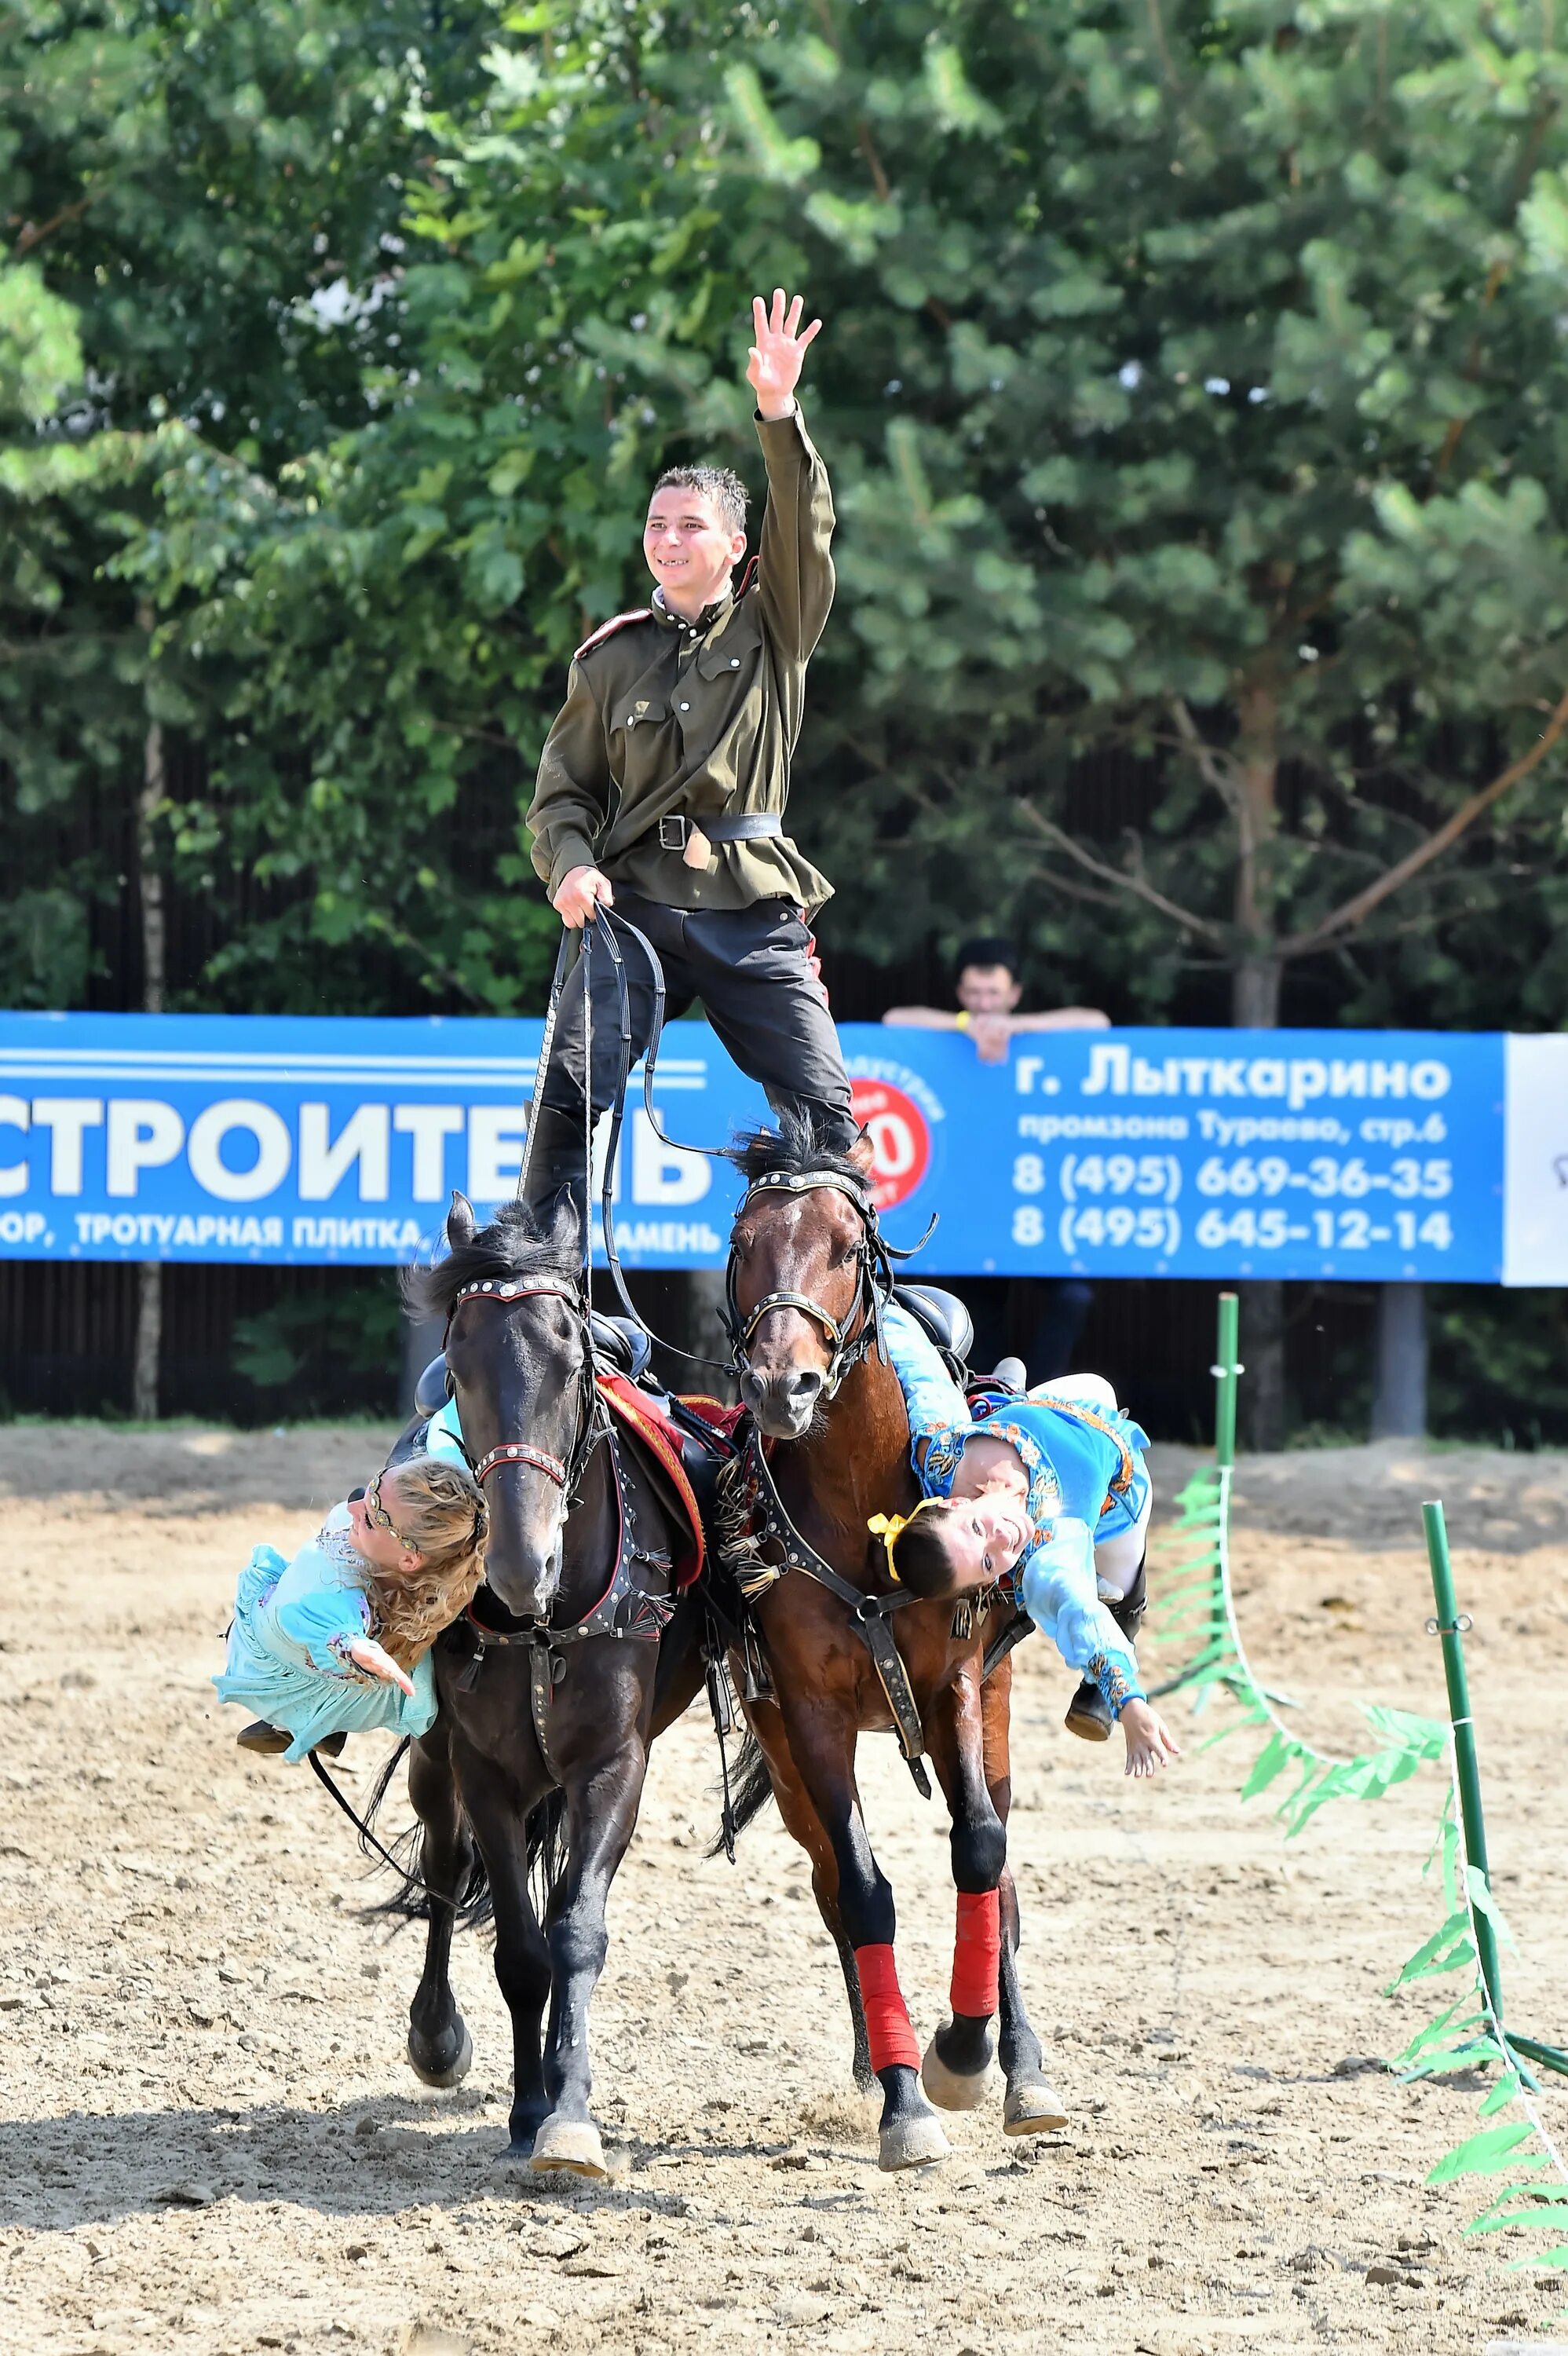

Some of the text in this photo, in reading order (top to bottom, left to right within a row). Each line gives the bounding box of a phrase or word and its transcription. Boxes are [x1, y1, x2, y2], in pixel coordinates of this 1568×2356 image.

[1014, 1044, 1452, 1111] г. Лыткарино
[1018, 1108, 1448, 1149] промзона Тураево, стр.6
[1011, 1152, 1453, 1205] 8 (495) 669-36-35
[75, 1213, 283, 1246] ТРОТУАРНАЯ
[1011, 1204, 1453, 1257] 8 (495) 645-12-14
